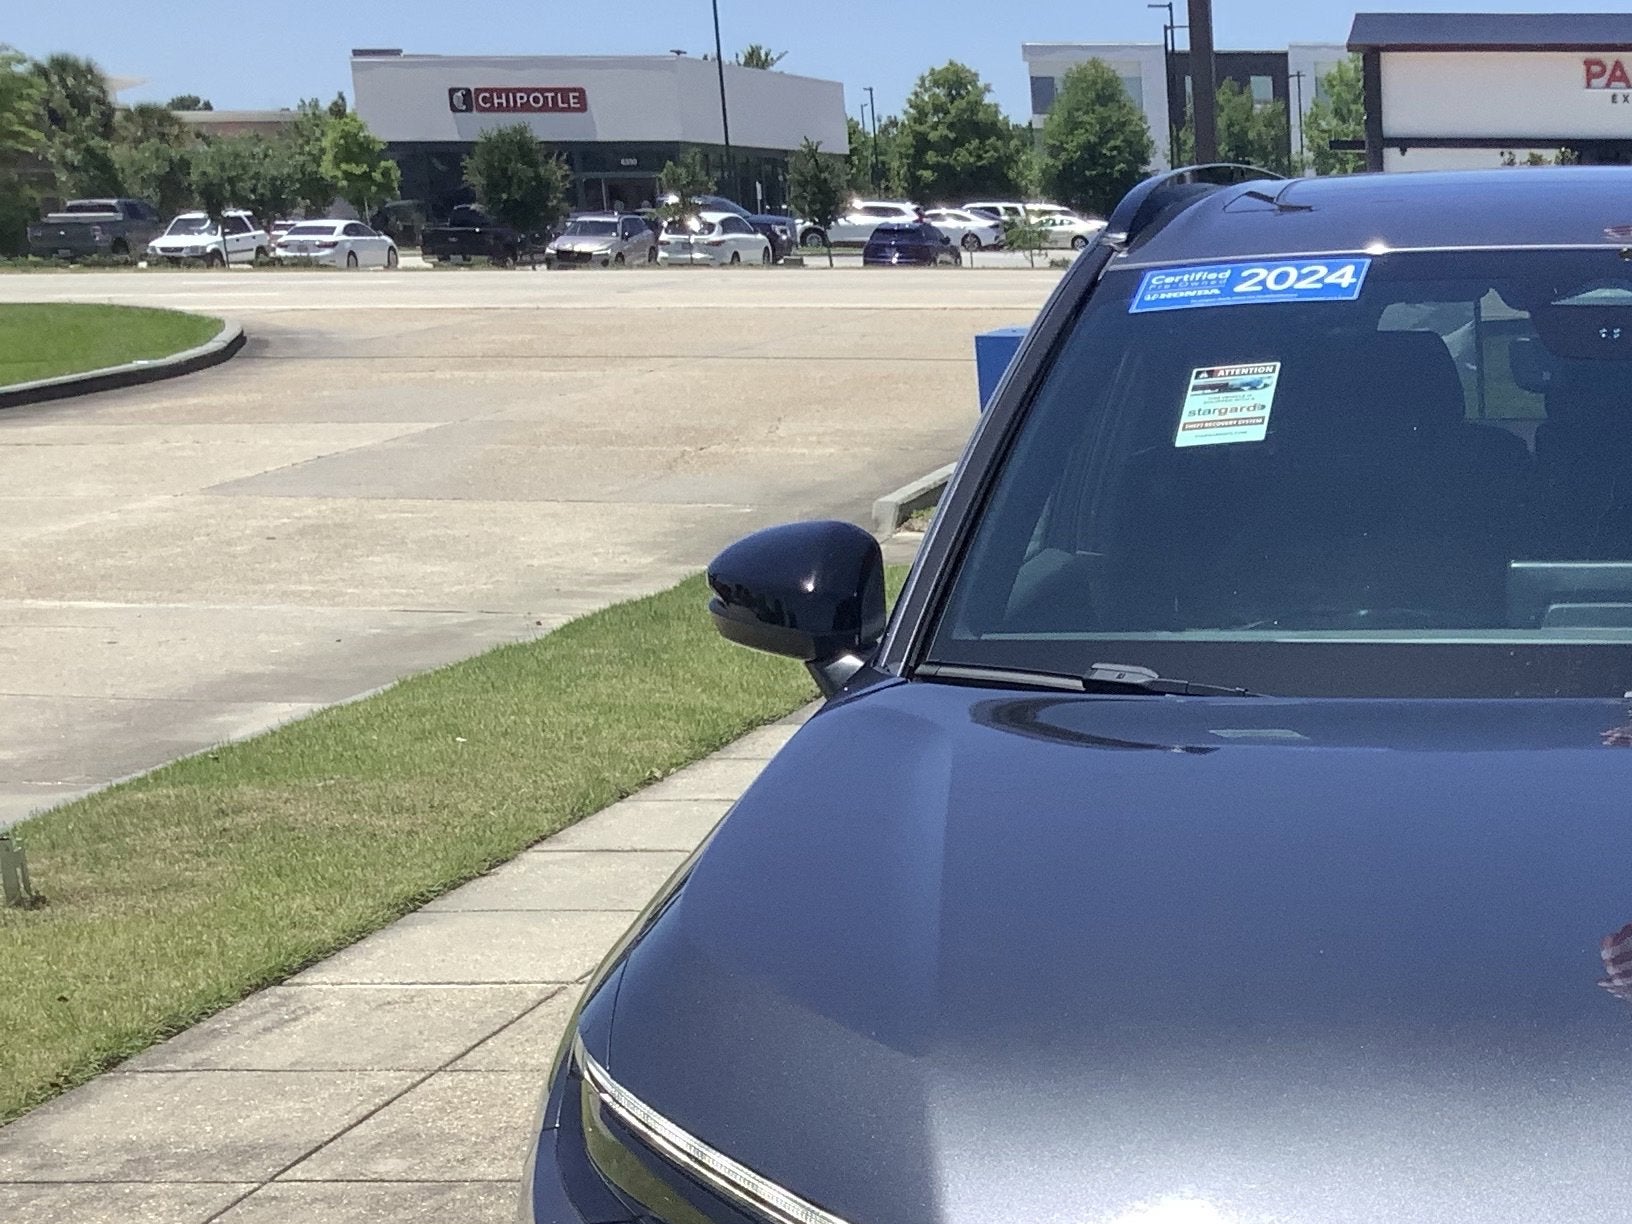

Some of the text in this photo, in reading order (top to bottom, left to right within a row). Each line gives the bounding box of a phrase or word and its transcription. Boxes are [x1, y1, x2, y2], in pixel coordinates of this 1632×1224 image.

[478, 92, 581, 108] CHIPOTLE
[1151, 264, 1357, 293] Certified 2024
[1217, 366, 1274, 377] ATTENTION
